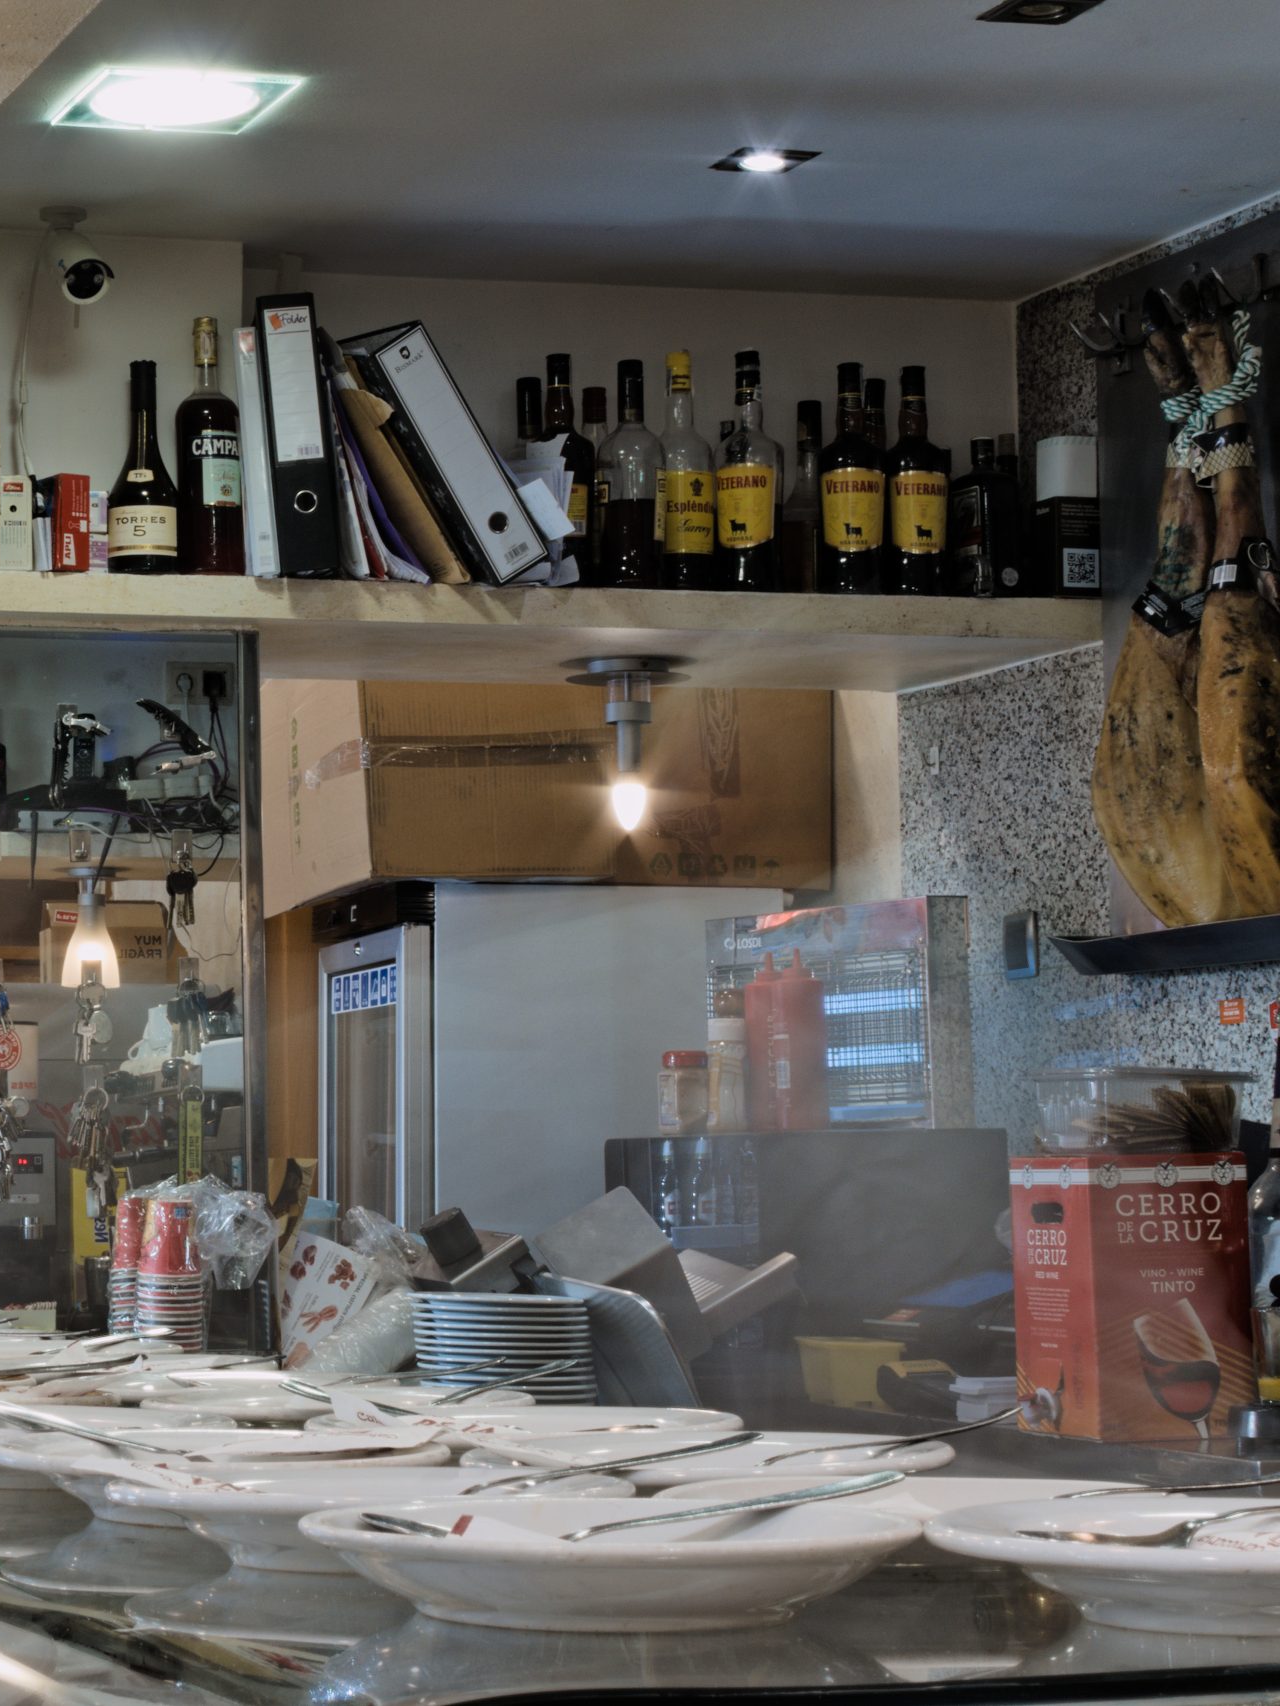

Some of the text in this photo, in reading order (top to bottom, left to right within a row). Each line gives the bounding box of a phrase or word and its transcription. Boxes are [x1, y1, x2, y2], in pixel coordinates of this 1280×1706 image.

[281, 312, 308, 324] Folder
[192, 438, 240, 456] CAMPA
[825, 480, 880, 495] VETERANO
[115, 516, 167, 525] TORRES
[133, 525, 146, 537] 5
[1115, 1191, 1222, 1217] CERRO
[1117, 1221, 1134, 1232] DE
[1139, 1218, 1223, 1243] CRUZ
[1026, 1229, 1067, 1246] CERRO
[1119, 1233, 1135, 1244] LA
[1034, 1248, 1068, 1265] CRUZ
[1140, 1268, 1167, 1278] VINO
[1176, 1267, 1205, 1277] WINE
[1151, 1280, 1196, 1293] TINTO
